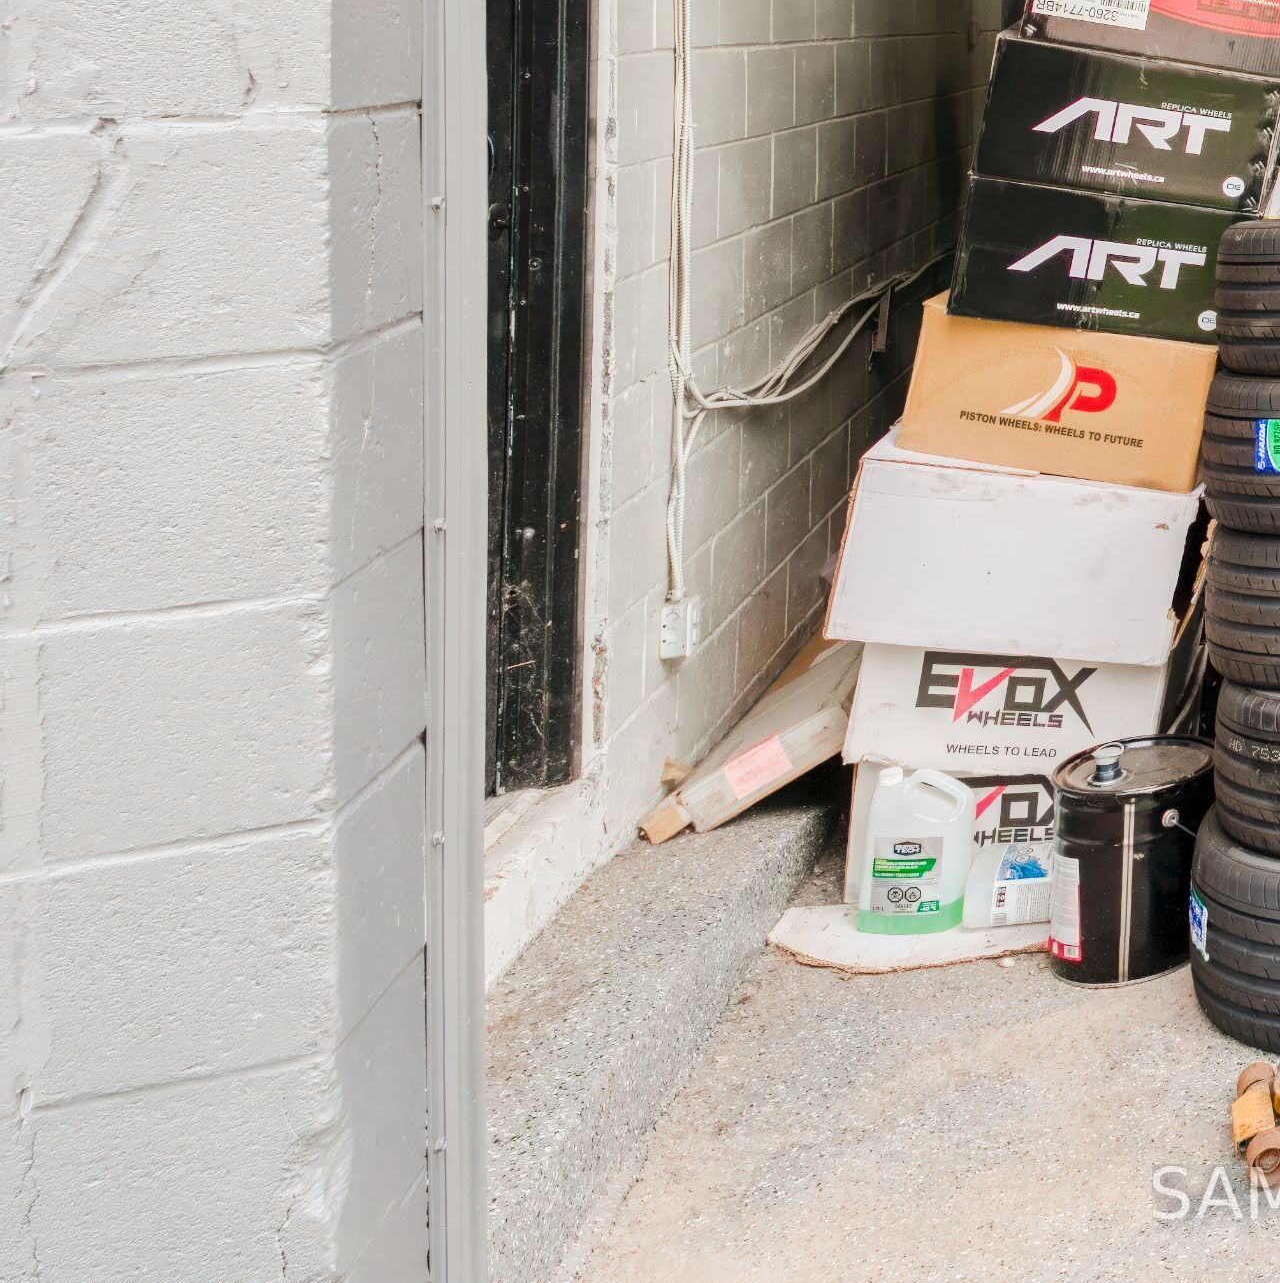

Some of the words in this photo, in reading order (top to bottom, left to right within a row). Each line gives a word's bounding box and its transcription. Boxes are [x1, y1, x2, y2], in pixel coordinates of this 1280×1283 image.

[1035, 0, 1119, 22] 3260-7714BR
[1161, 102, 1197, 114] REPLICA
[1199, 107, 1232, 119] WHEELS
[1032, 96, 1231, 155] ART
[1081, 164, 1165, 183] www.artwheels.ca
[1136, 237, 1173, 249] REPLICA
[1174, 243, 1207, 253] WHEELS
[1007, 235, 1206, 290] ART
[1056, 302, 1140, 319] www.artwheels.ca
[959, 410, 996, 425] PISTON
[999, 416, 1042, 432] WHEELS:
[1045, 424, 1086, 439] WHEELS
[1089, 431, 1101, 441] TO
[1104, 434, 1144, 448] FUTURE
[967, 709, 1063, 728] WHEELS
[946, 744, 1000, 755] WHEELS
[1005, 747, 1020, 756] TO
[1024, 747, 1057, 758] LEAD
